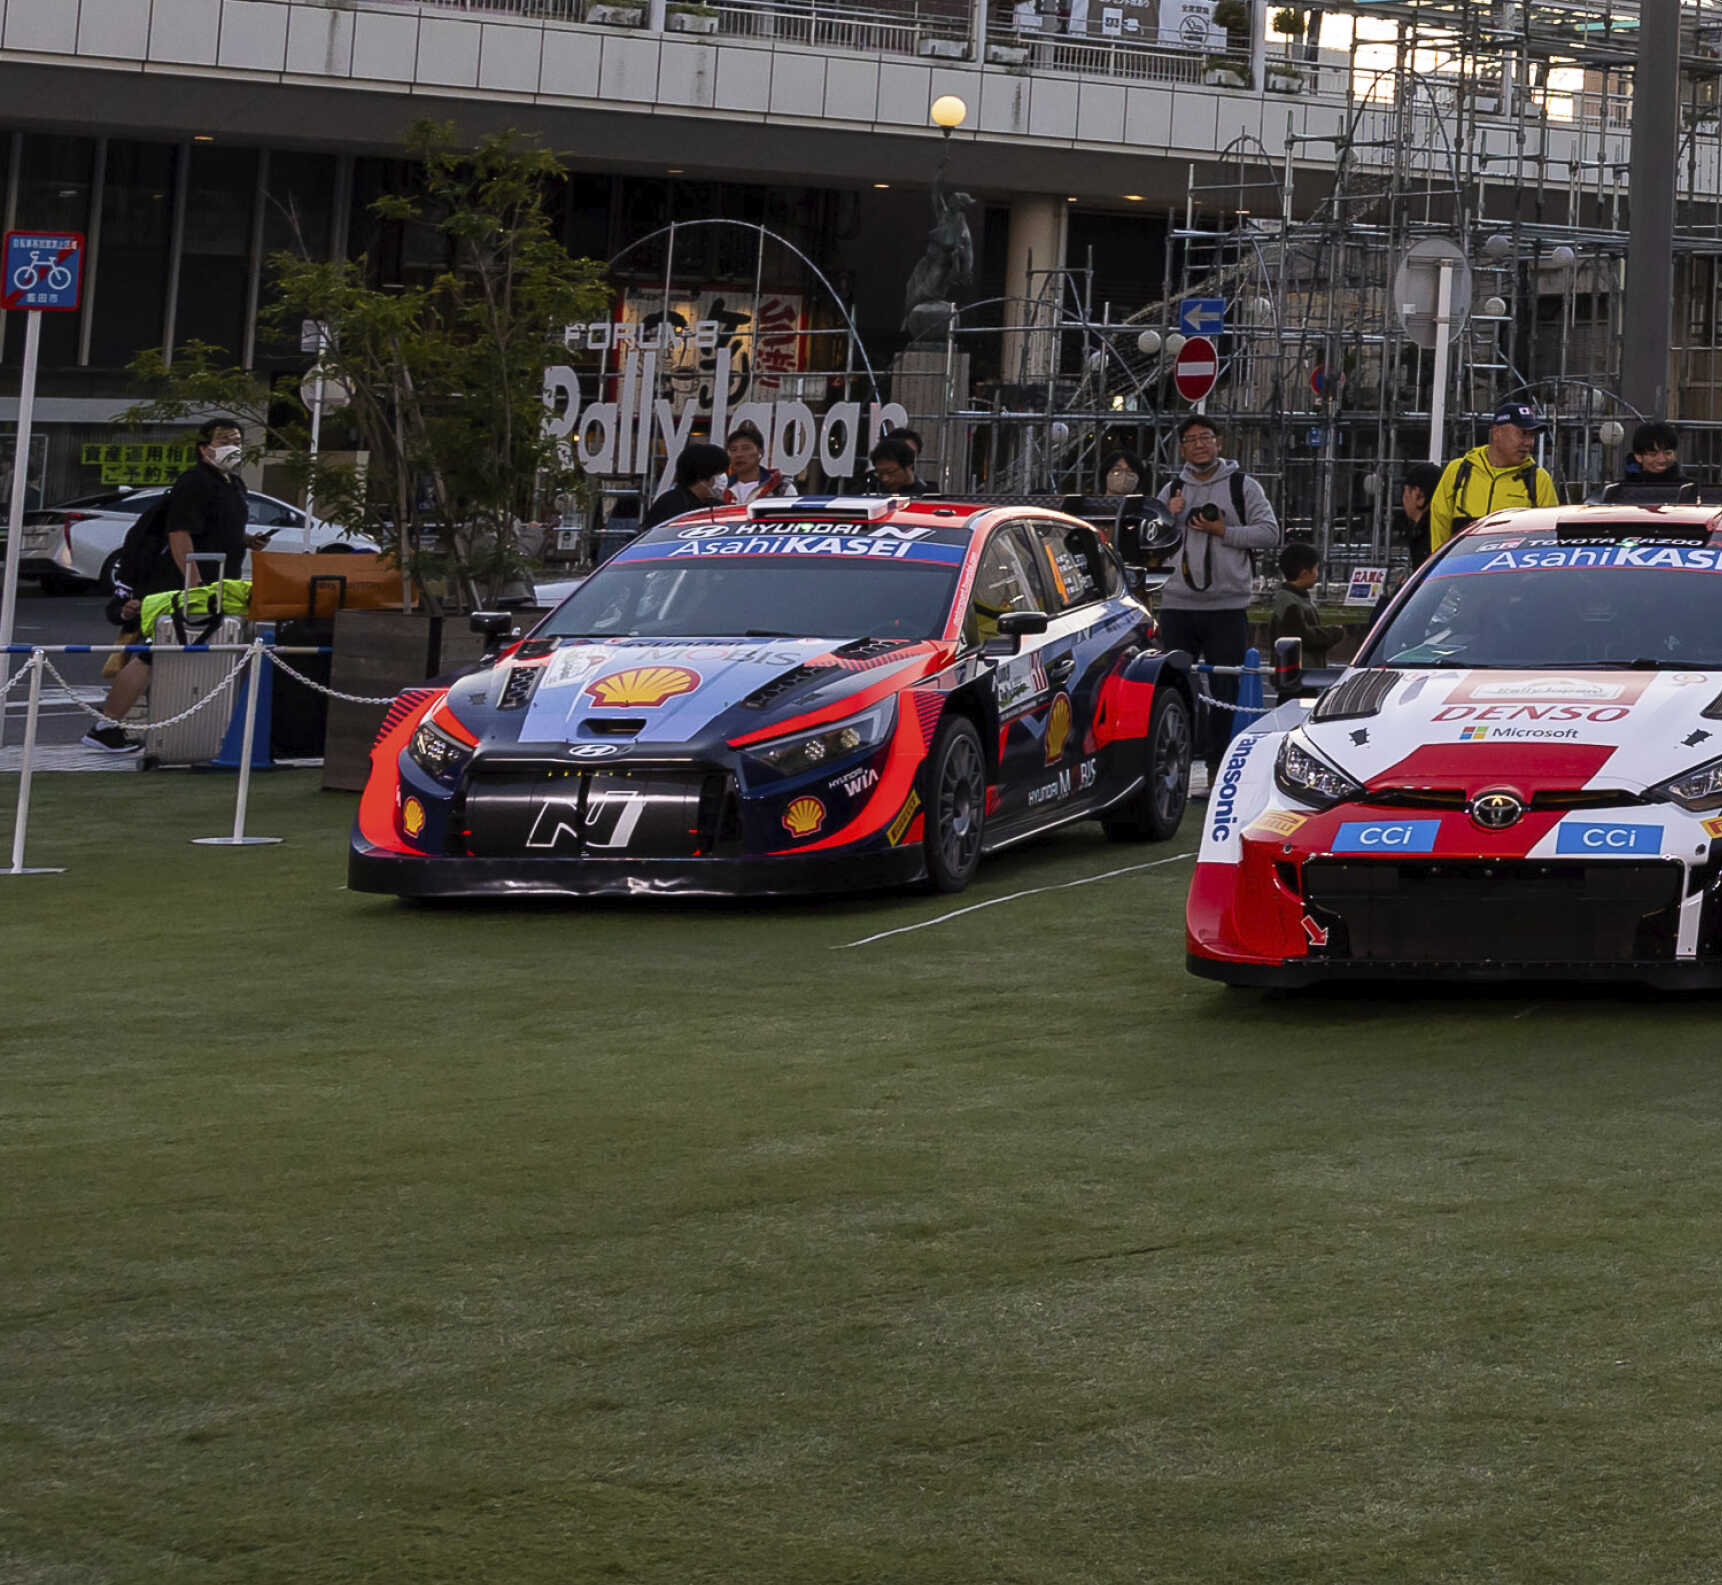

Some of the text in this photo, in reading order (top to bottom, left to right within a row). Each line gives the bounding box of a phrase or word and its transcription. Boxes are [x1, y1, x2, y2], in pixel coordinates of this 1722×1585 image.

[735, 523, 861, 535] HYUNDAI
[668, 536, 914, 558] AsahiKASEI
[1527, 537, 1616, 547] TOYOTA
[1430, 705, 1631, 722] DENSO
[1491, 726, 1580, 740] Microsoft
[1359, 827, 1414, 846] CCi
[1582, 829, 1637, 848] CCi
